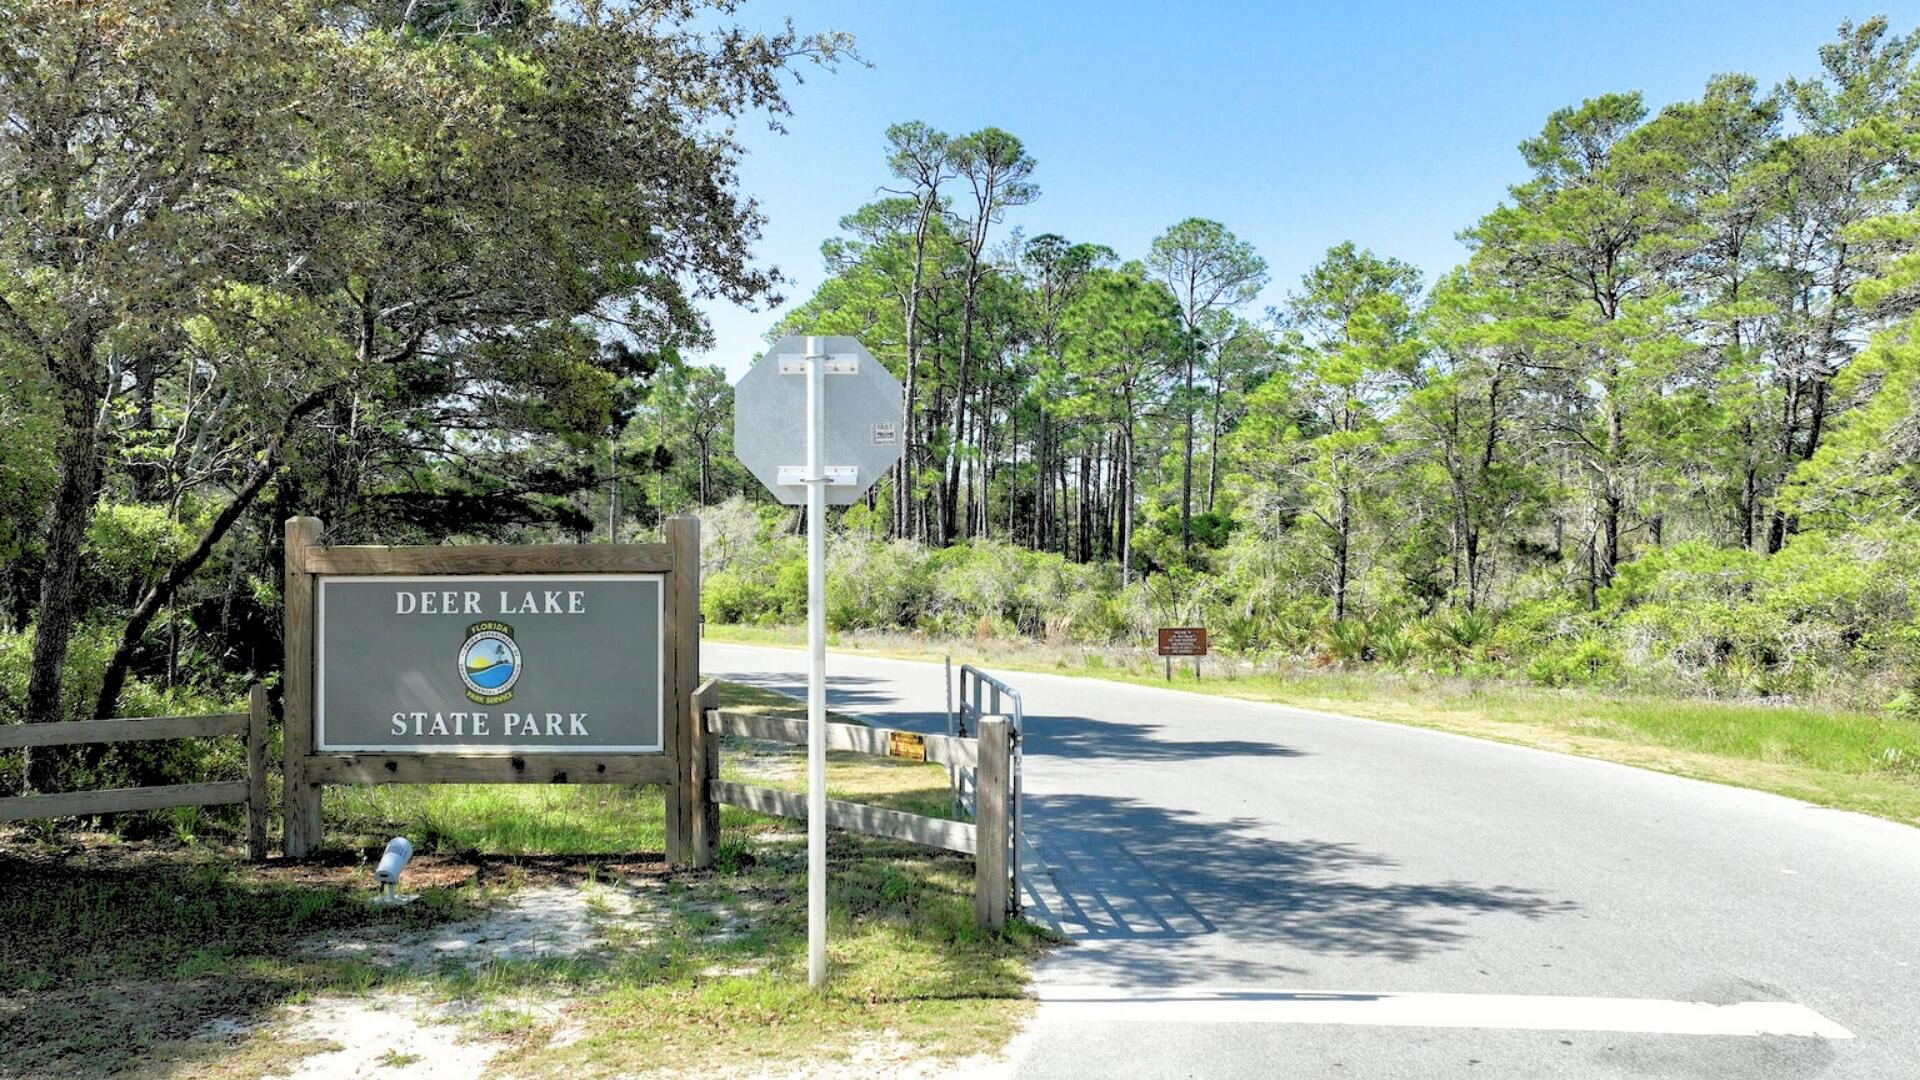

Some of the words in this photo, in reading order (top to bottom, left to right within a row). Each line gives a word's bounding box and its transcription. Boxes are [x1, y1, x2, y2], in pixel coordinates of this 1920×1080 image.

[395, 591, 482, 614] DEER
[500, 591, 585, 614] LAKE
[471, 622, 509, 634] FLORIDA
[466, 690, 485, 703] PARK
[485, 691, 513, 704] SERVICE
[391, 711, 489, 736] STATE
[502, 711, 588, 736] PARK
